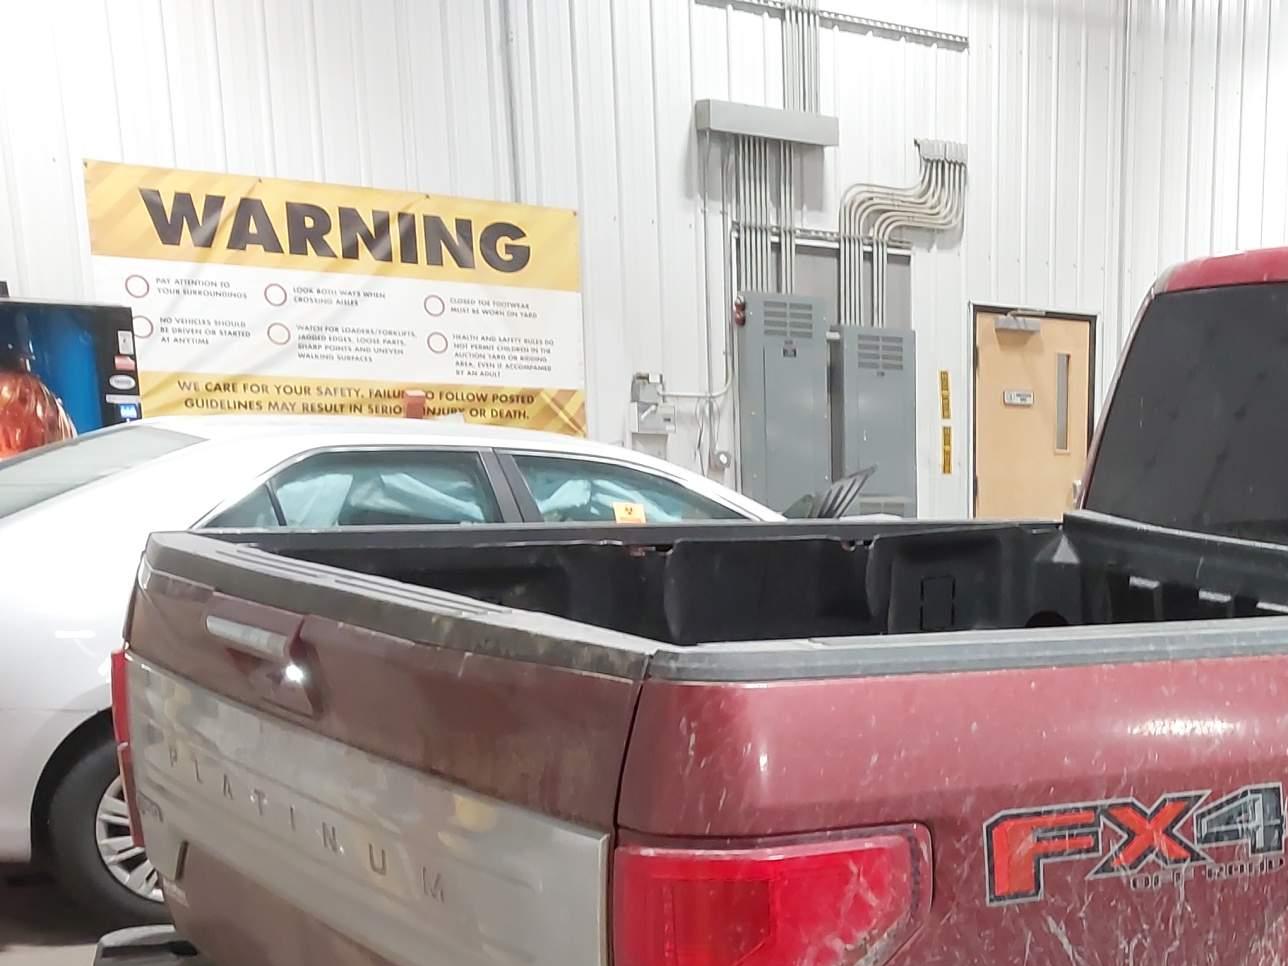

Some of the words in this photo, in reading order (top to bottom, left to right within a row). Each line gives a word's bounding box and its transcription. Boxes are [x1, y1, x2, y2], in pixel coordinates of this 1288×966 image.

[139, 188, 531, 273] WARNING
[175, 278, 217, 288] ATTENTION
[183, 288, 248, 300] SURROUNDINGS
[294, 296, 333, 305] CROSSING
[336, 298, 359, 306] AISLES
[450, 297, 476, 305] CLOSED
[478, 298, 490, 306] TOE
[492, 300, 530, 309] FOOTWEAR
[482, 309, 505, 317] WORN
[520, 311, 538, 319] YARD
[175, 318, 211, 326] VEHICLES
[214, 320, 246, 328] SHOULD
[171, 327, 202, 336] DRIVEN
[219, 329, 251, 338] STARTED
[296, 324, 323, 333] WATCH
[325, 325, 339, 333] FOR
[173, 336, 209, 345] ANYTIME
[298, 334, 327, 342] JAGGED
[356, 337, 380, 345] LOOSE
[499, 336, 522, 344] SAFETY
[298, 343, 322, 351] SHARP
[324, 344, 352, 352] POINTS
[374, 347, 404, 355] UNEVEN
[298, 353, 334, 361] WALKING
[337, 355, 373, 363] SURFACES
[454, 352, 486, 360] AUCTION
[488, 353, 506, 361] YARD
[480, 370, 501, 378] ADULT
[177, 380, 200, 392] WE
[204, 381, 237, 393] CARE
[243, 383, 269, 394] FOR
[274, 384, 311, 396] YOUR
[439, 392, 488, 403] FOLLOW
[492, 393, 535, 405] POSTED
[184, 397, 263, 411] GUIDELINES
[268, 401, 300, 412] MAY
[302, 402, 346, 414] RESULT
[350, 403, 363, 414] IN
[367, 404, 403, 415] SERIO
[470, 407, 487, 418] OR
[491, 409, 529, 420] DEATH.
[169, 744, 446, 902] PLATINUM
[983, 781, 1285, 905] FX4
